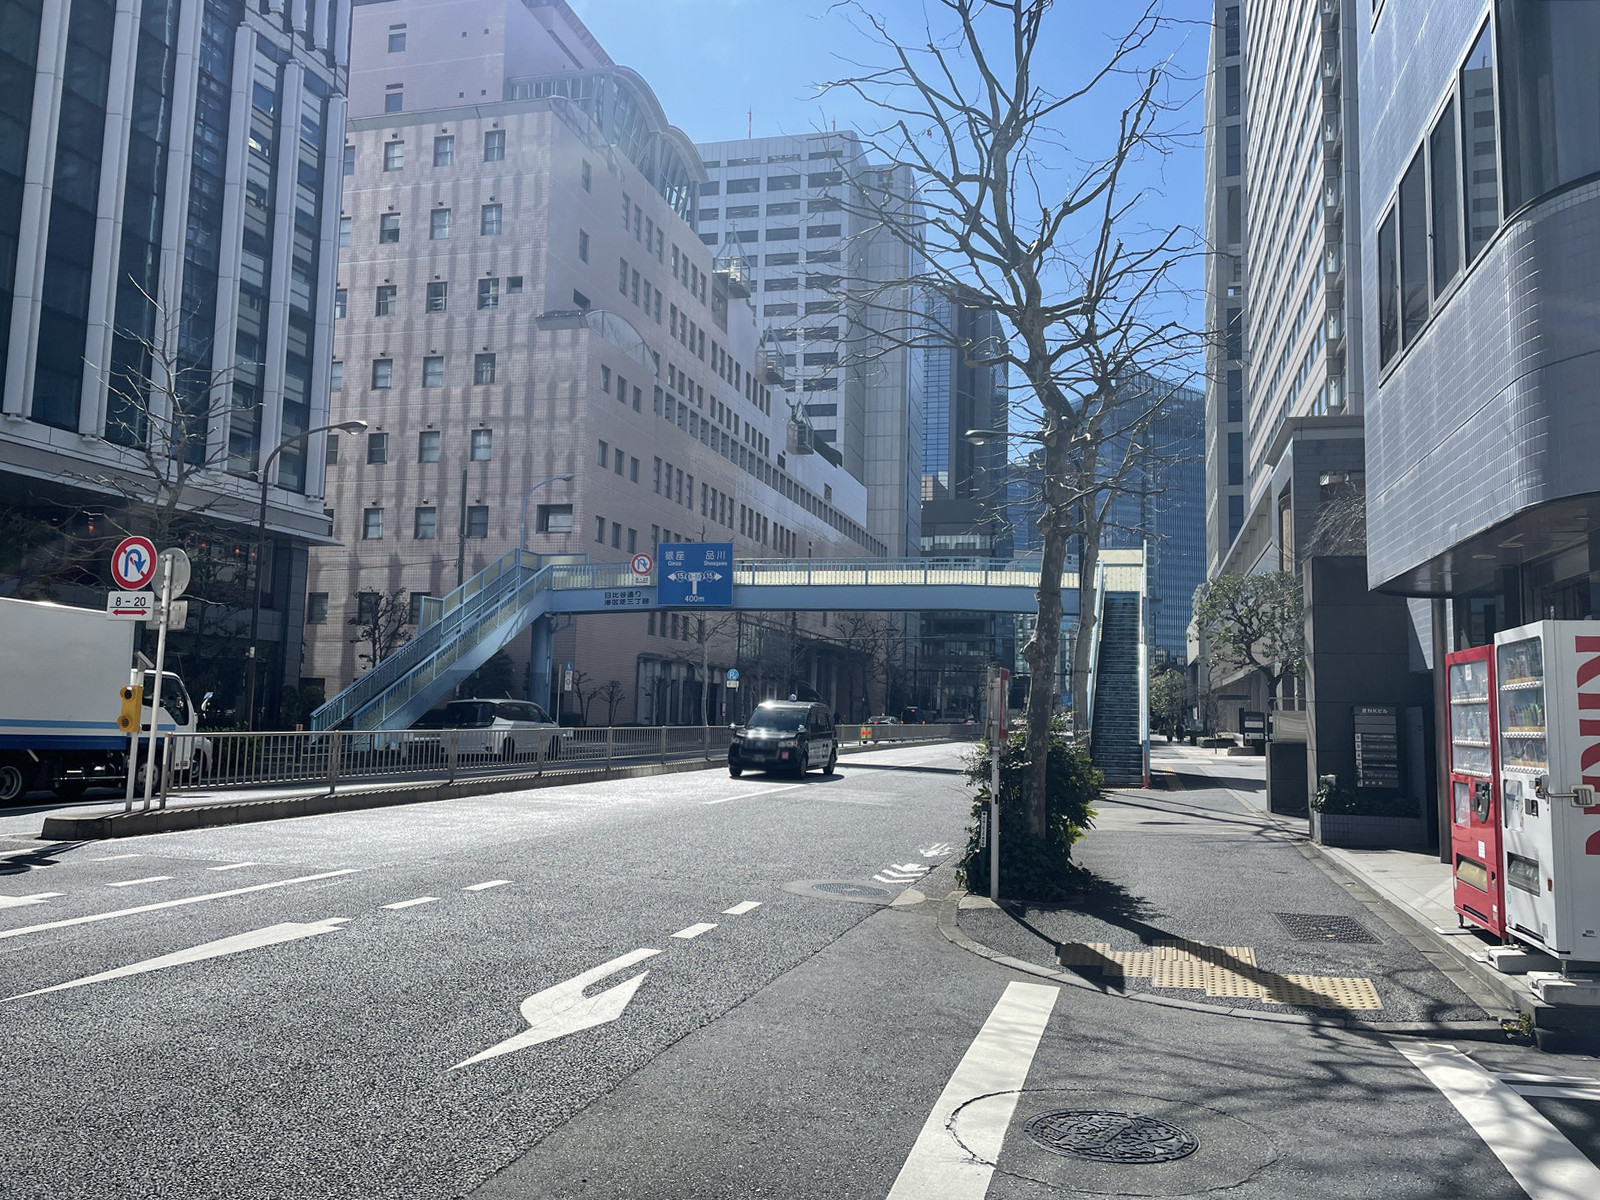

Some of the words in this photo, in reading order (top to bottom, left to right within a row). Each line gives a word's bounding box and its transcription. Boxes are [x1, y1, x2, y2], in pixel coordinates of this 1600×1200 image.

[664, 550, 685, 560] 銀座
[705, 550, 726, 560] 品川
[116, 596, 122, 606] 8
[134, 596, 146, 606] 20
